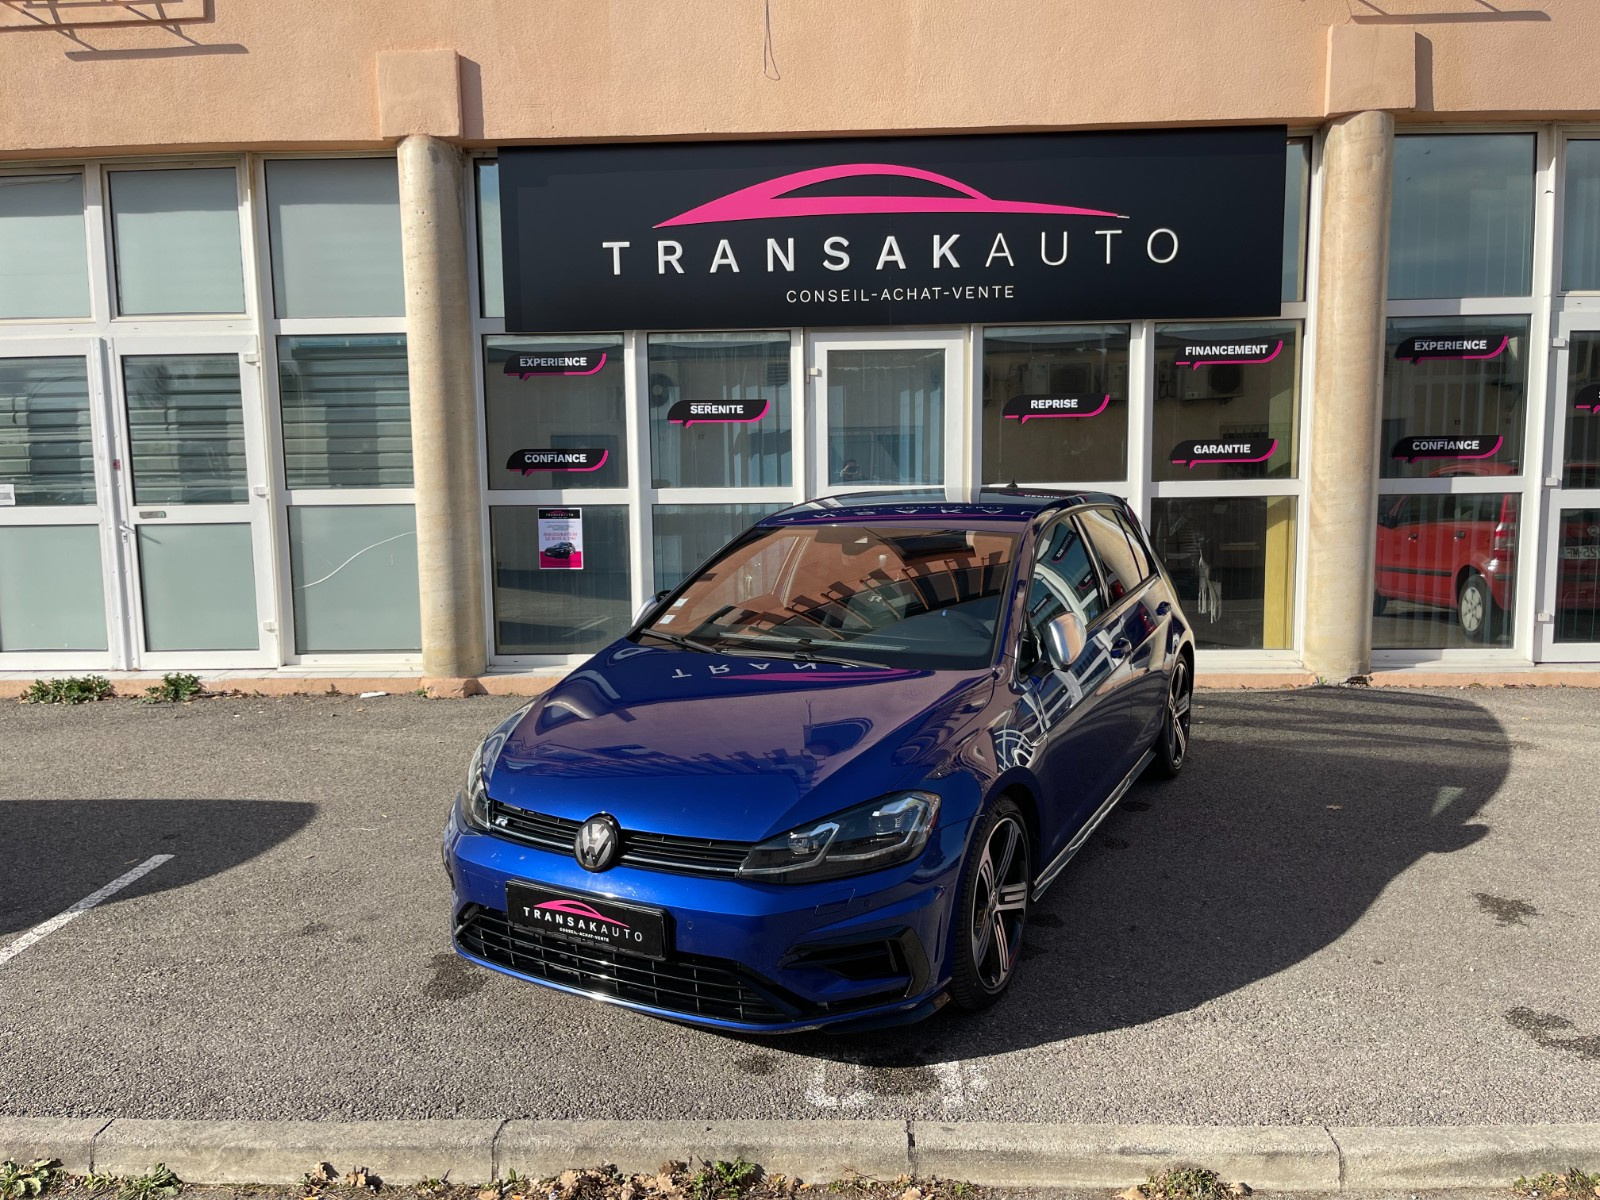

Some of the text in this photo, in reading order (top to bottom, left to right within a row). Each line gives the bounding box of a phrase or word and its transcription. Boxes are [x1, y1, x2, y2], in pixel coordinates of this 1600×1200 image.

[602, 226, 1179, 276] TRANSAKAUTO
[786, 285, 1015, 303] CONSEIL-ACHAT-VENTE
[1185, 344, 1269, 356] FINANCEMENT
[1414, 339, 1487, 351] EXPERIENCE
[519, 356, 588, 367] EXPERIENCE
[690, 404, 744, 415] SERENITE
[1030, 398, 1079, 409] REPRISE
[1193, 443, 1251, 455] GARANTIE
[1412, 439, 1480, 451] CONFIANCE
[524, 452, 588, 464] CONFIANCE
[522, 906, 643, 943] TRANSAKAUTO
